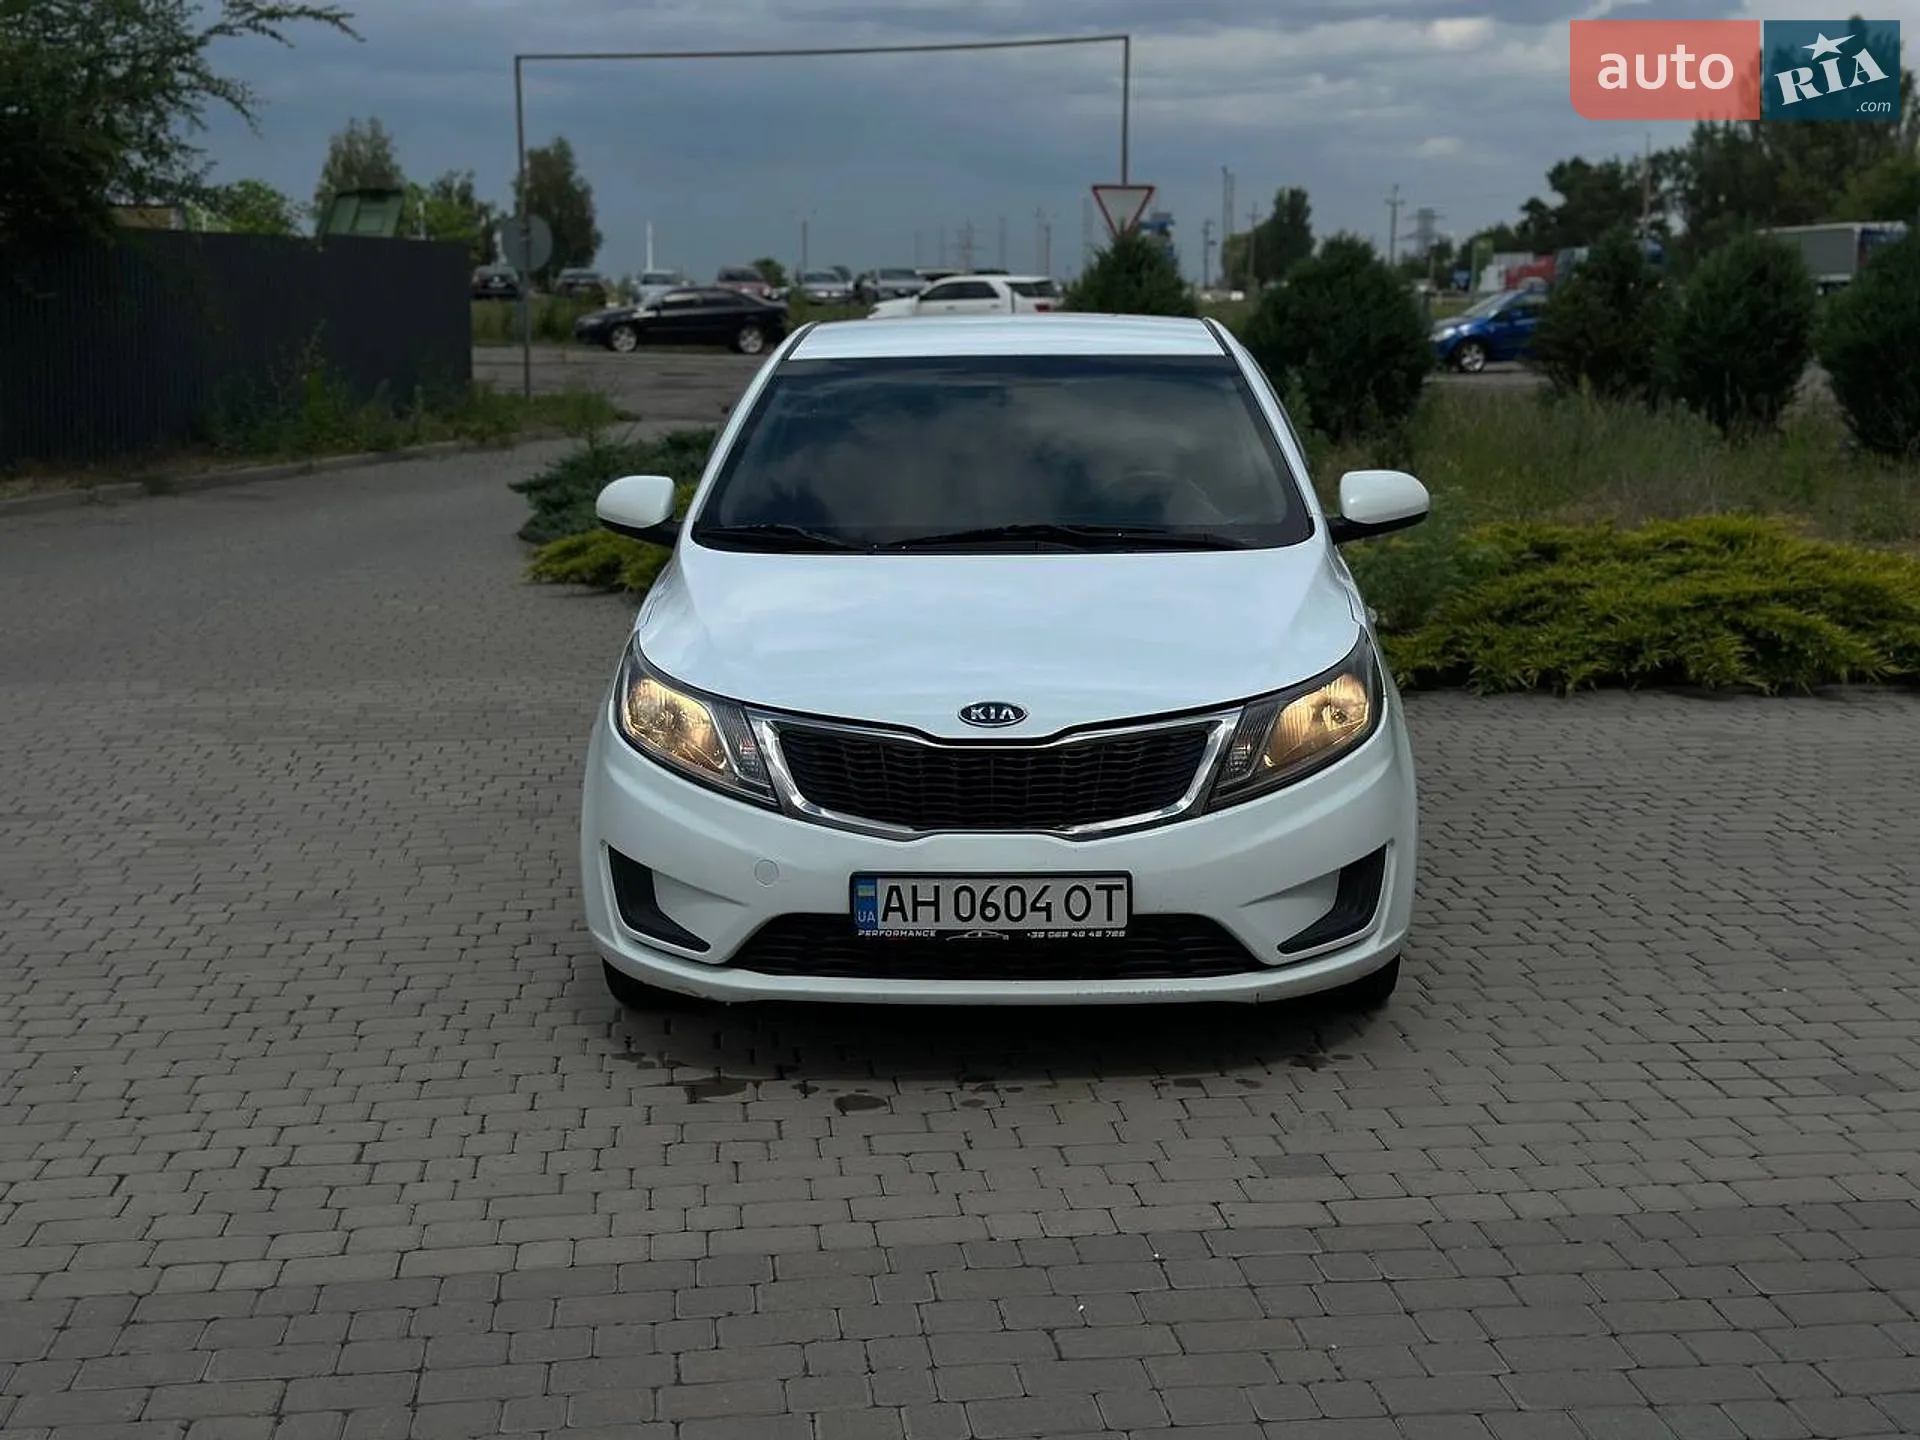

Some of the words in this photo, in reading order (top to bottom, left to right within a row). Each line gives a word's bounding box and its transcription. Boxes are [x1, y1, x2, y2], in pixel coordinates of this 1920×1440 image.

[970, 706, 1016, 720] KIA
[881, 885, 941, 922] AH
[953, 884, 1053, 922] 0604
[1063, 884, 1125, 922] OT
[858, 911, 876, 923] UA
